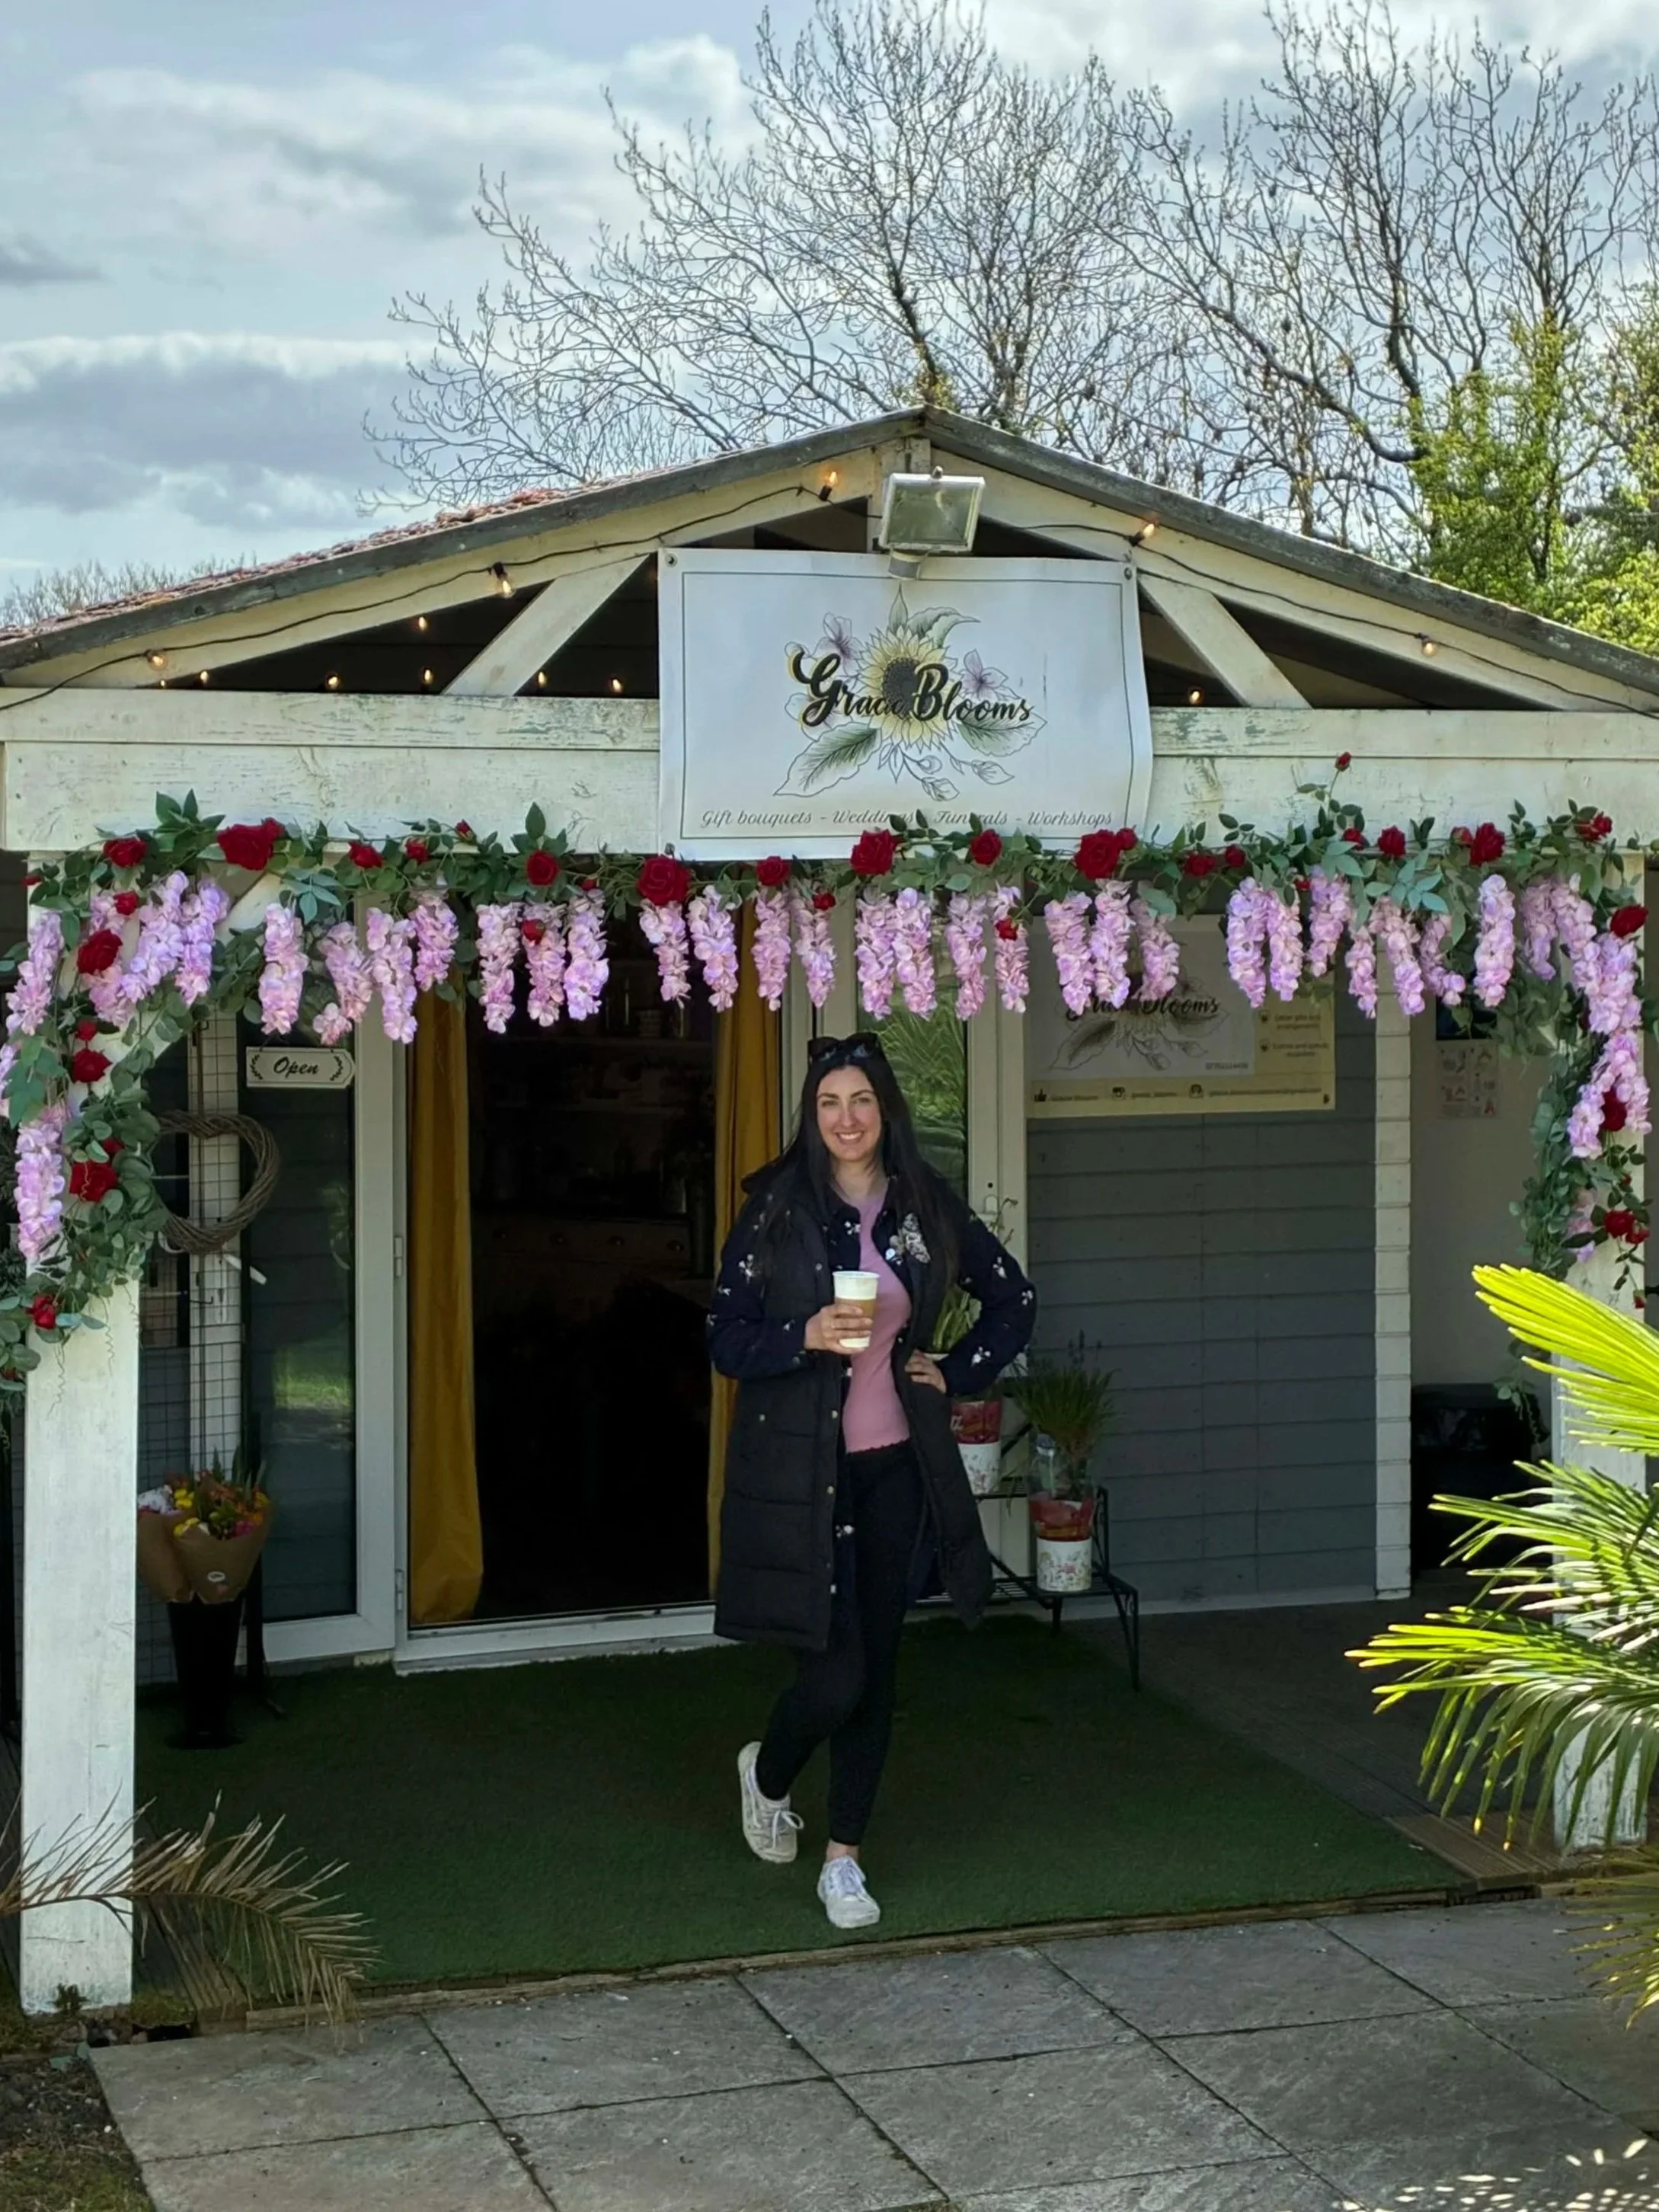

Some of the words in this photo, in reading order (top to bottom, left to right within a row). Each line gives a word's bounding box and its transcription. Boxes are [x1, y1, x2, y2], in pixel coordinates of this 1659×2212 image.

[792, 647, 906, 726] Grace
[913, 663, 1034, 721] Blooms
[700, 810, 733, 829] Gift
[737, 810, 812, 828] bouquets
[934, 810, 1009, 825] Funrals
[1028, 811, 1112, 829] Workshops
[273, 1056, 319, 1079] Open
